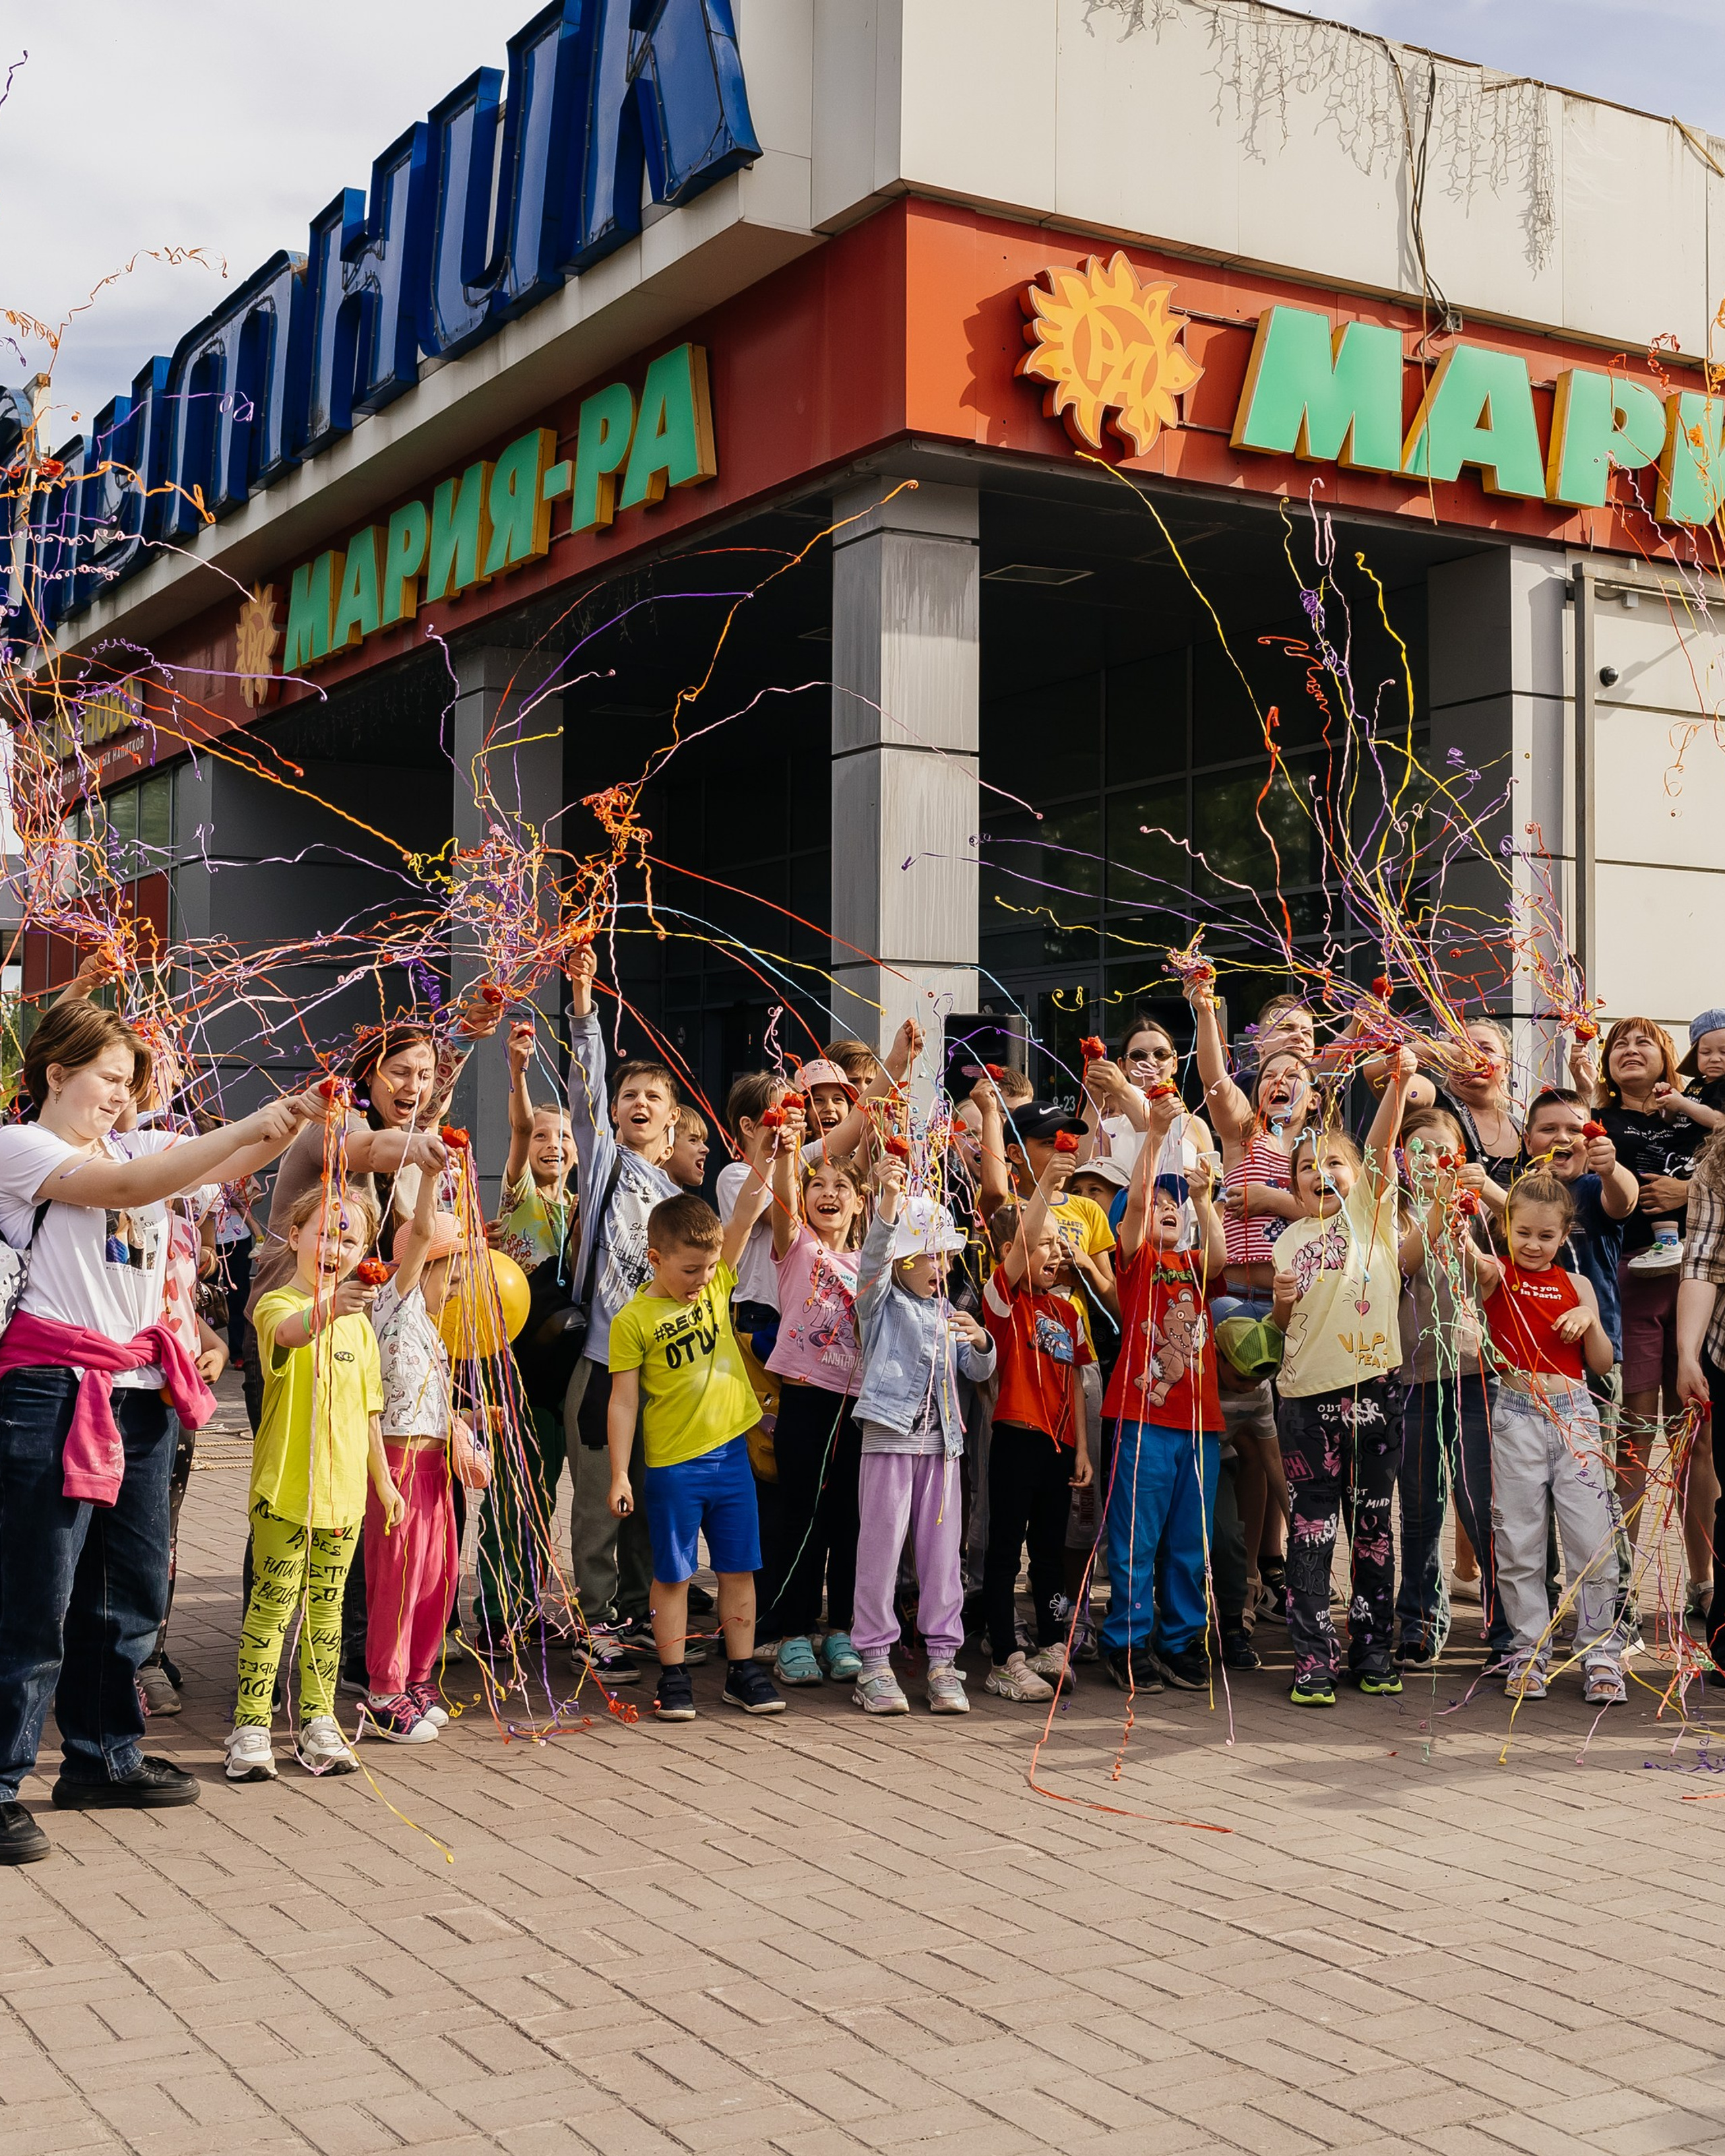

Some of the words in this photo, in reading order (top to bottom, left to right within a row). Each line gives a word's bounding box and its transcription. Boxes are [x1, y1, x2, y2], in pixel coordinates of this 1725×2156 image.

[282, 342, 716, 674] МАРИЯ-РА
[1317, 1404, 1342, 1413] OUT
[1321, 1414, 1339, 1422] OF
[1365, 1498, 1391, 1509] MIND
